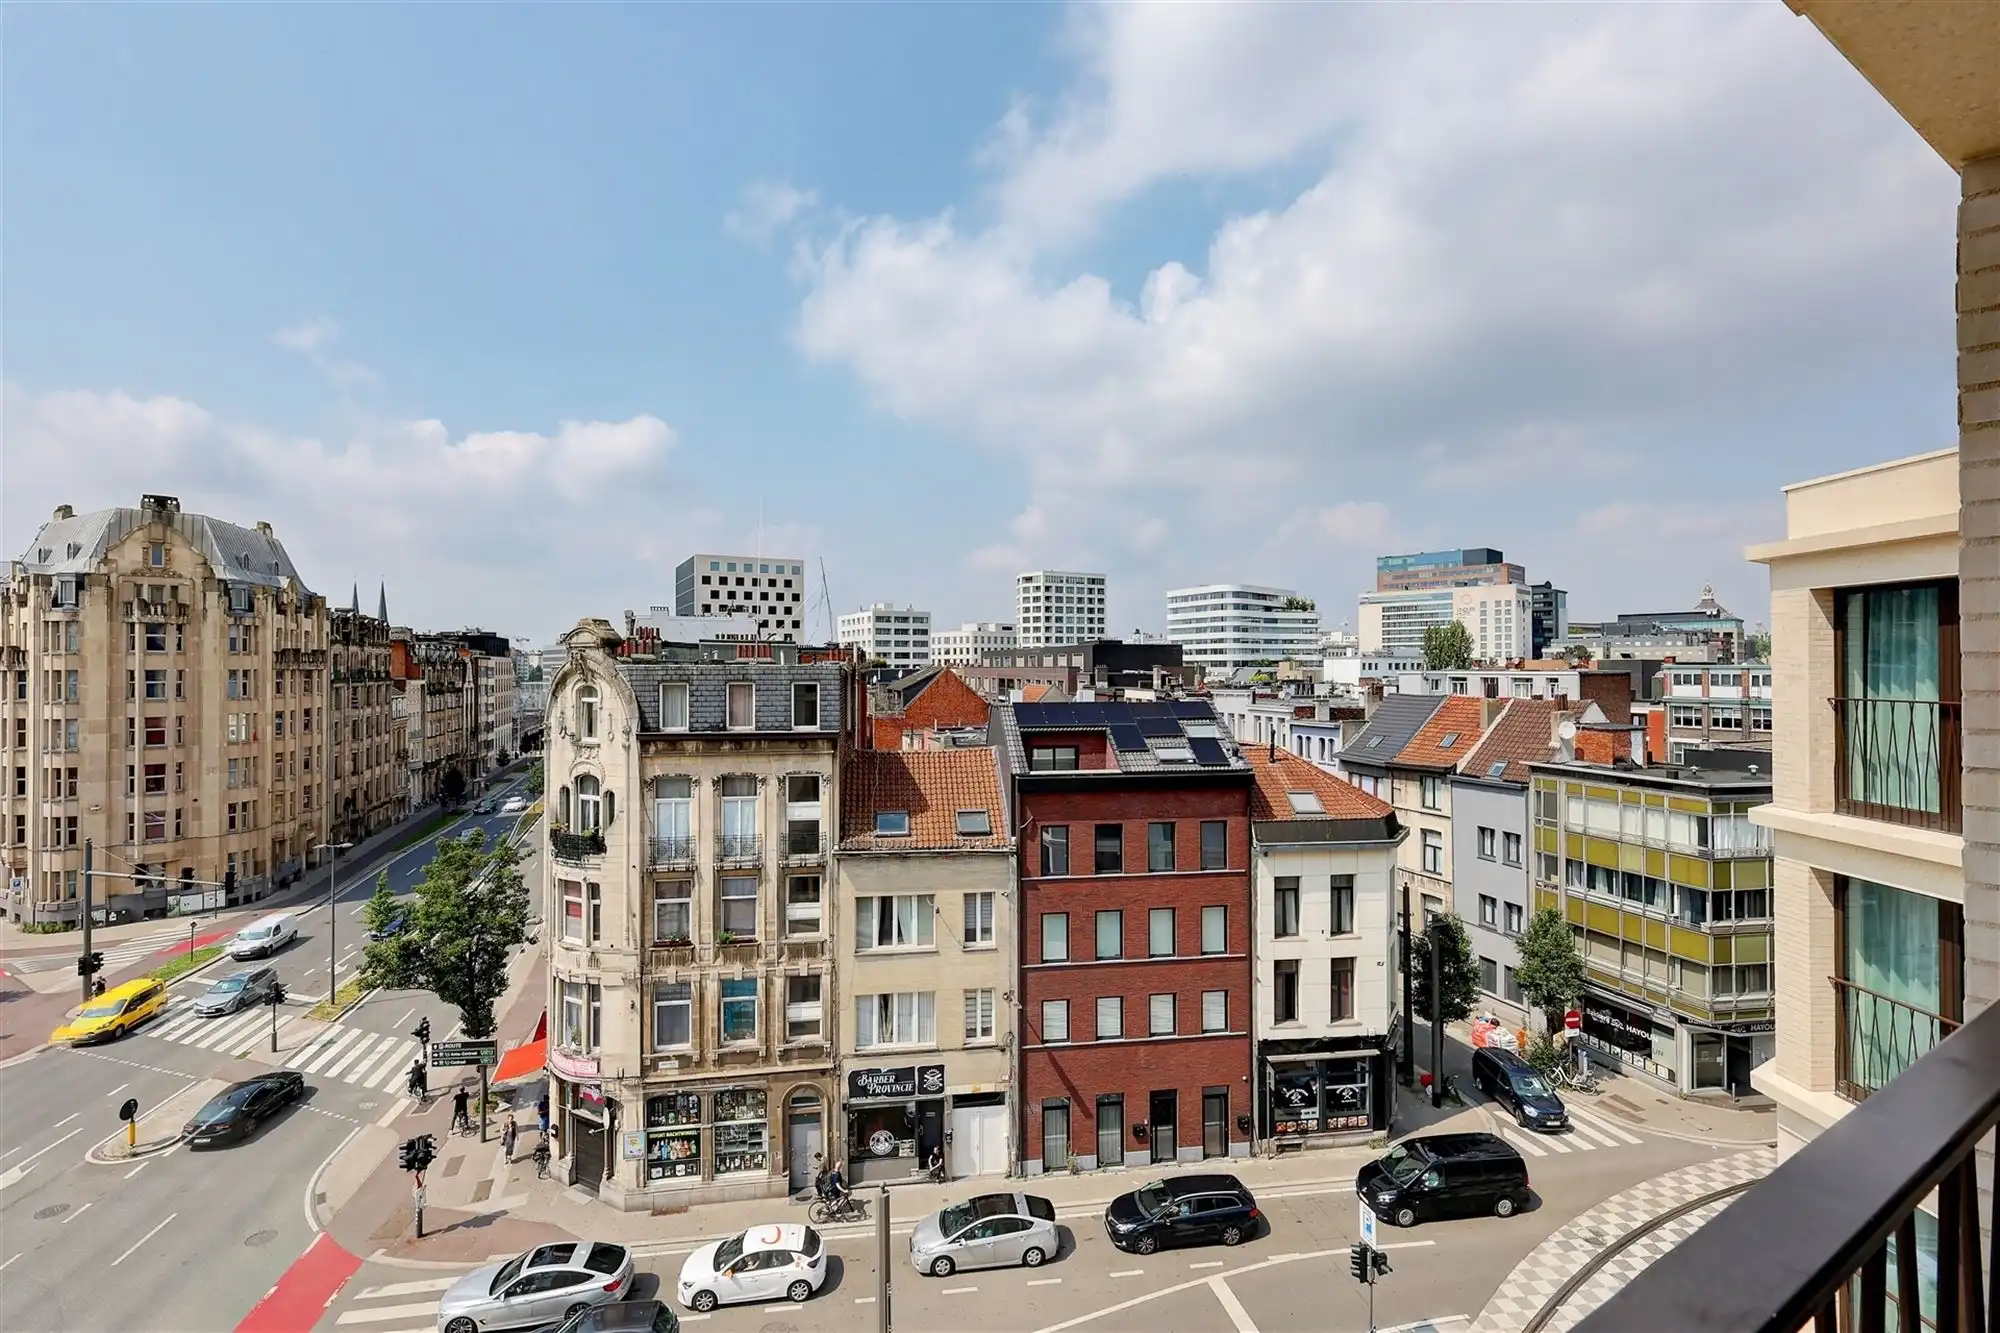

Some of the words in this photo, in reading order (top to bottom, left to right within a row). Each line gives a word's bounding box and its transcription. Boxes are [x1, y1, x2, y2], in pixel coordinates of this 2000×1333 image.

[1750, 1023, 1775, 1031] HAYOU
[857, 1074, 895, 1087] BARBER
[867, 1083, 914, 1094] PROVINCIE
